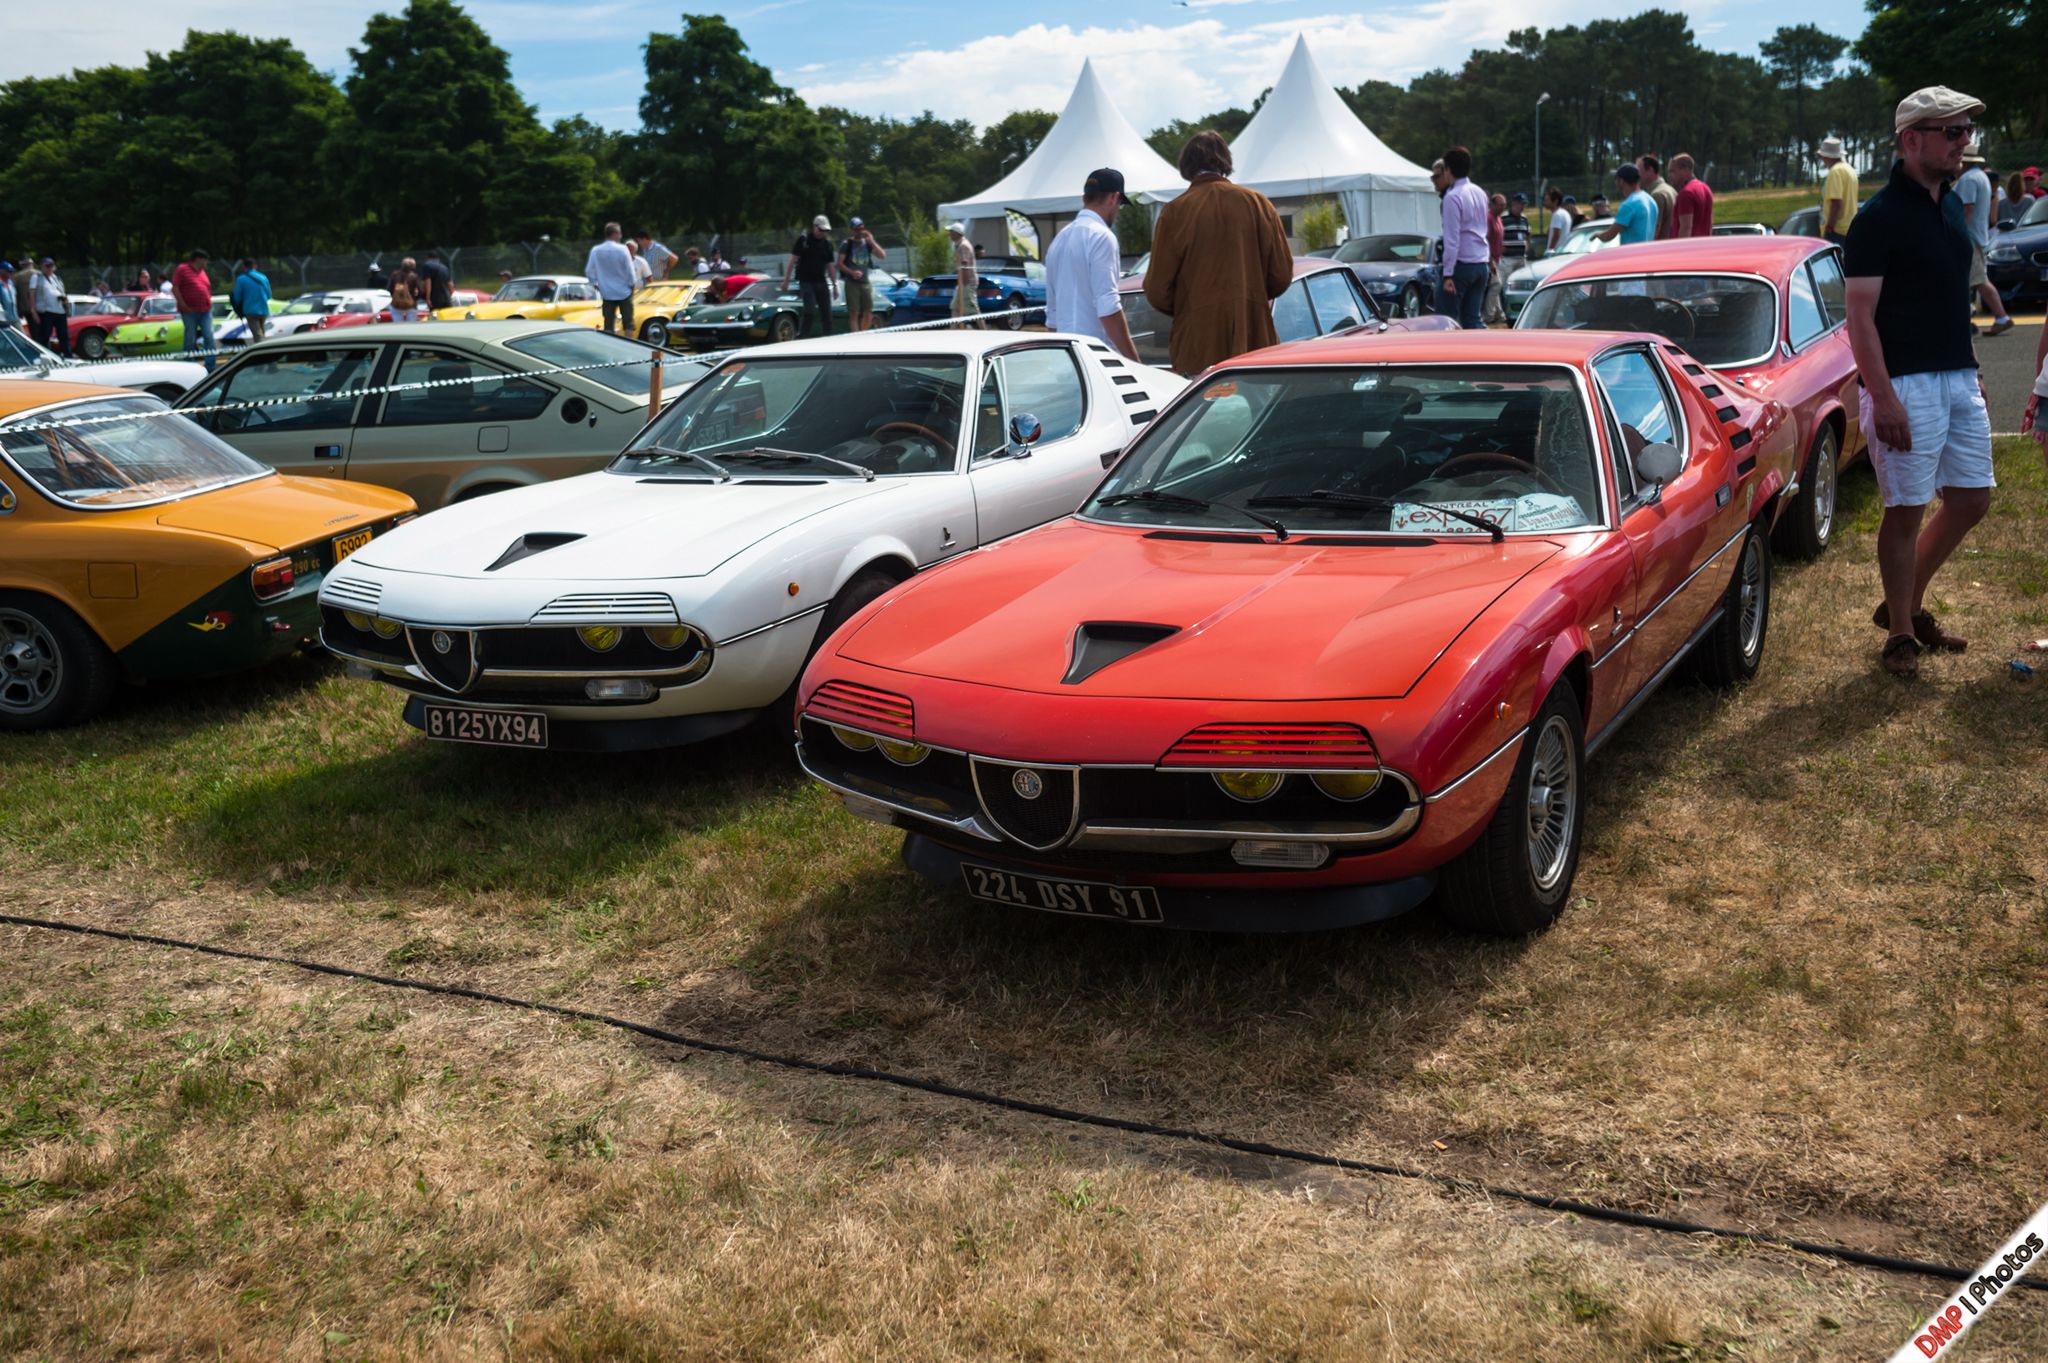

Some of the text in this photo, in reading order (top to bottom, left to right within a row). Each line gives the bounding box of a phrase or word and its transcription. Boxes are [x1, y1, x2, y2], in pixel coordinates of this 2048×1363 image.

[431, 710, 540, 741] 8125YX94
[972, 868, 1147, 919] 224 DSY 91
